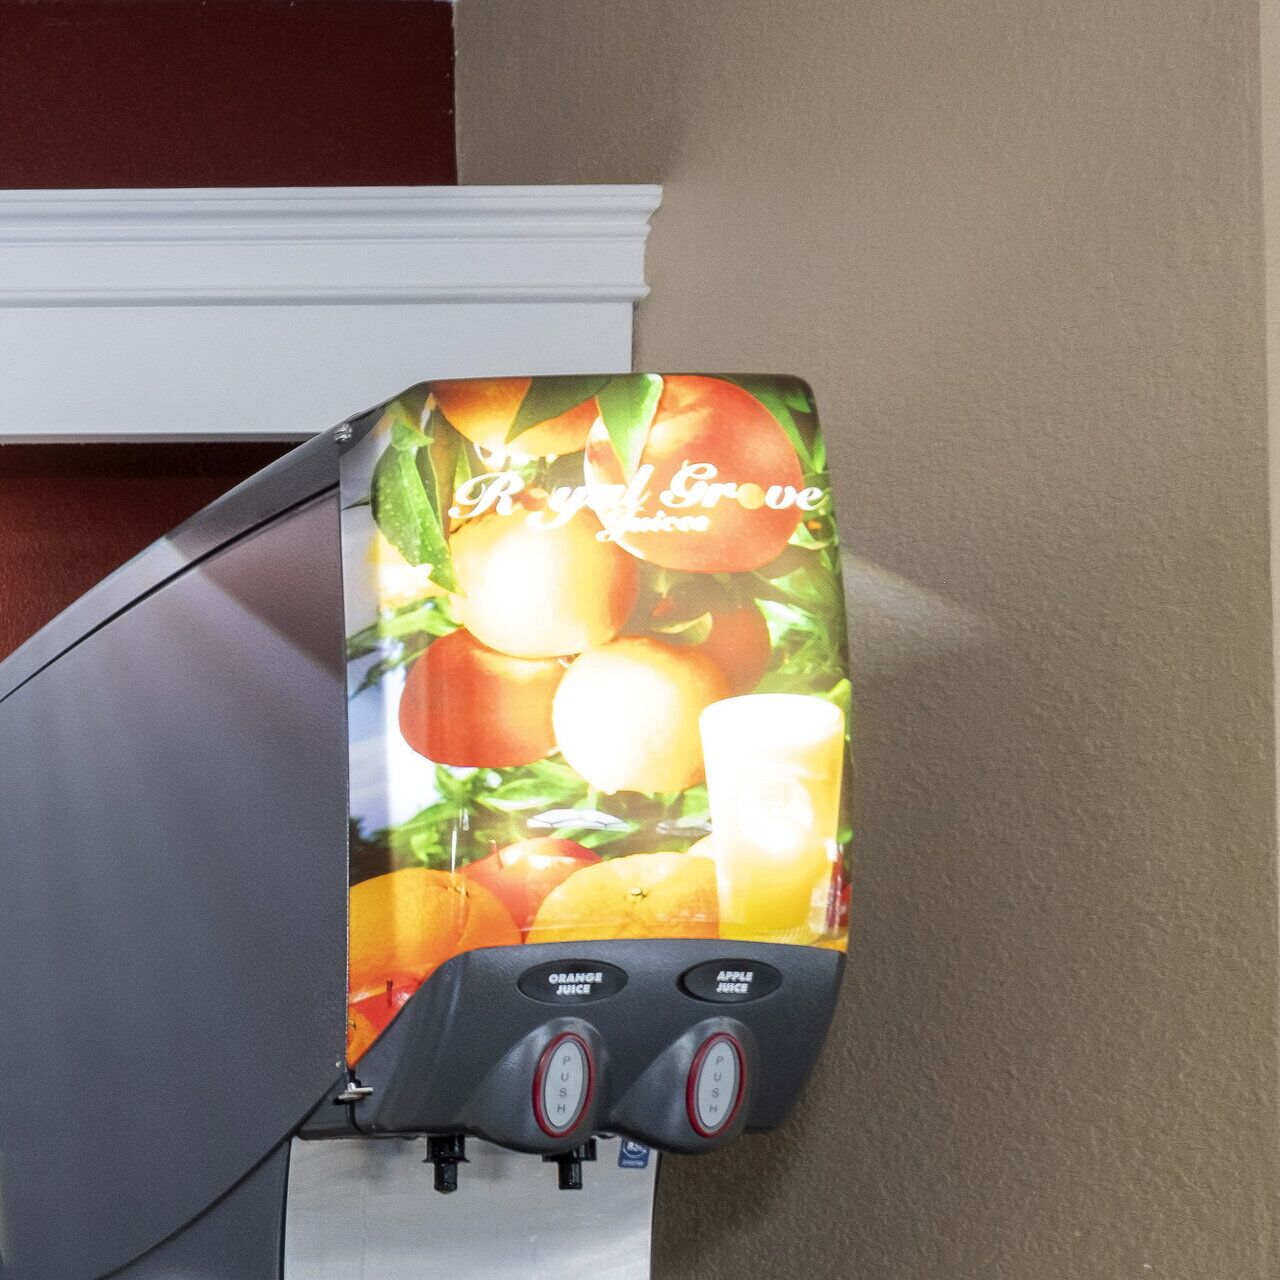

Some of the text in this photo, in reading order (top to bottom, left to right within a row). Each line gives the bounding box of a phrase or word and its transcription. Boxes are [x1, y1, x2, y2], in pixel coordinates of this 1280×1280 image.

[659, 460, 827, 511] Grove
[548, 972, 603, 985] ORANGE
[716, 971, 753, 982] APPLE
[556, 984, 592, 996] JUICE
[716, 982, 749, 994] JUICE
[556, 1055, 571, 1114] PUSH
[708, 1055, 724, 1114] PUSH
